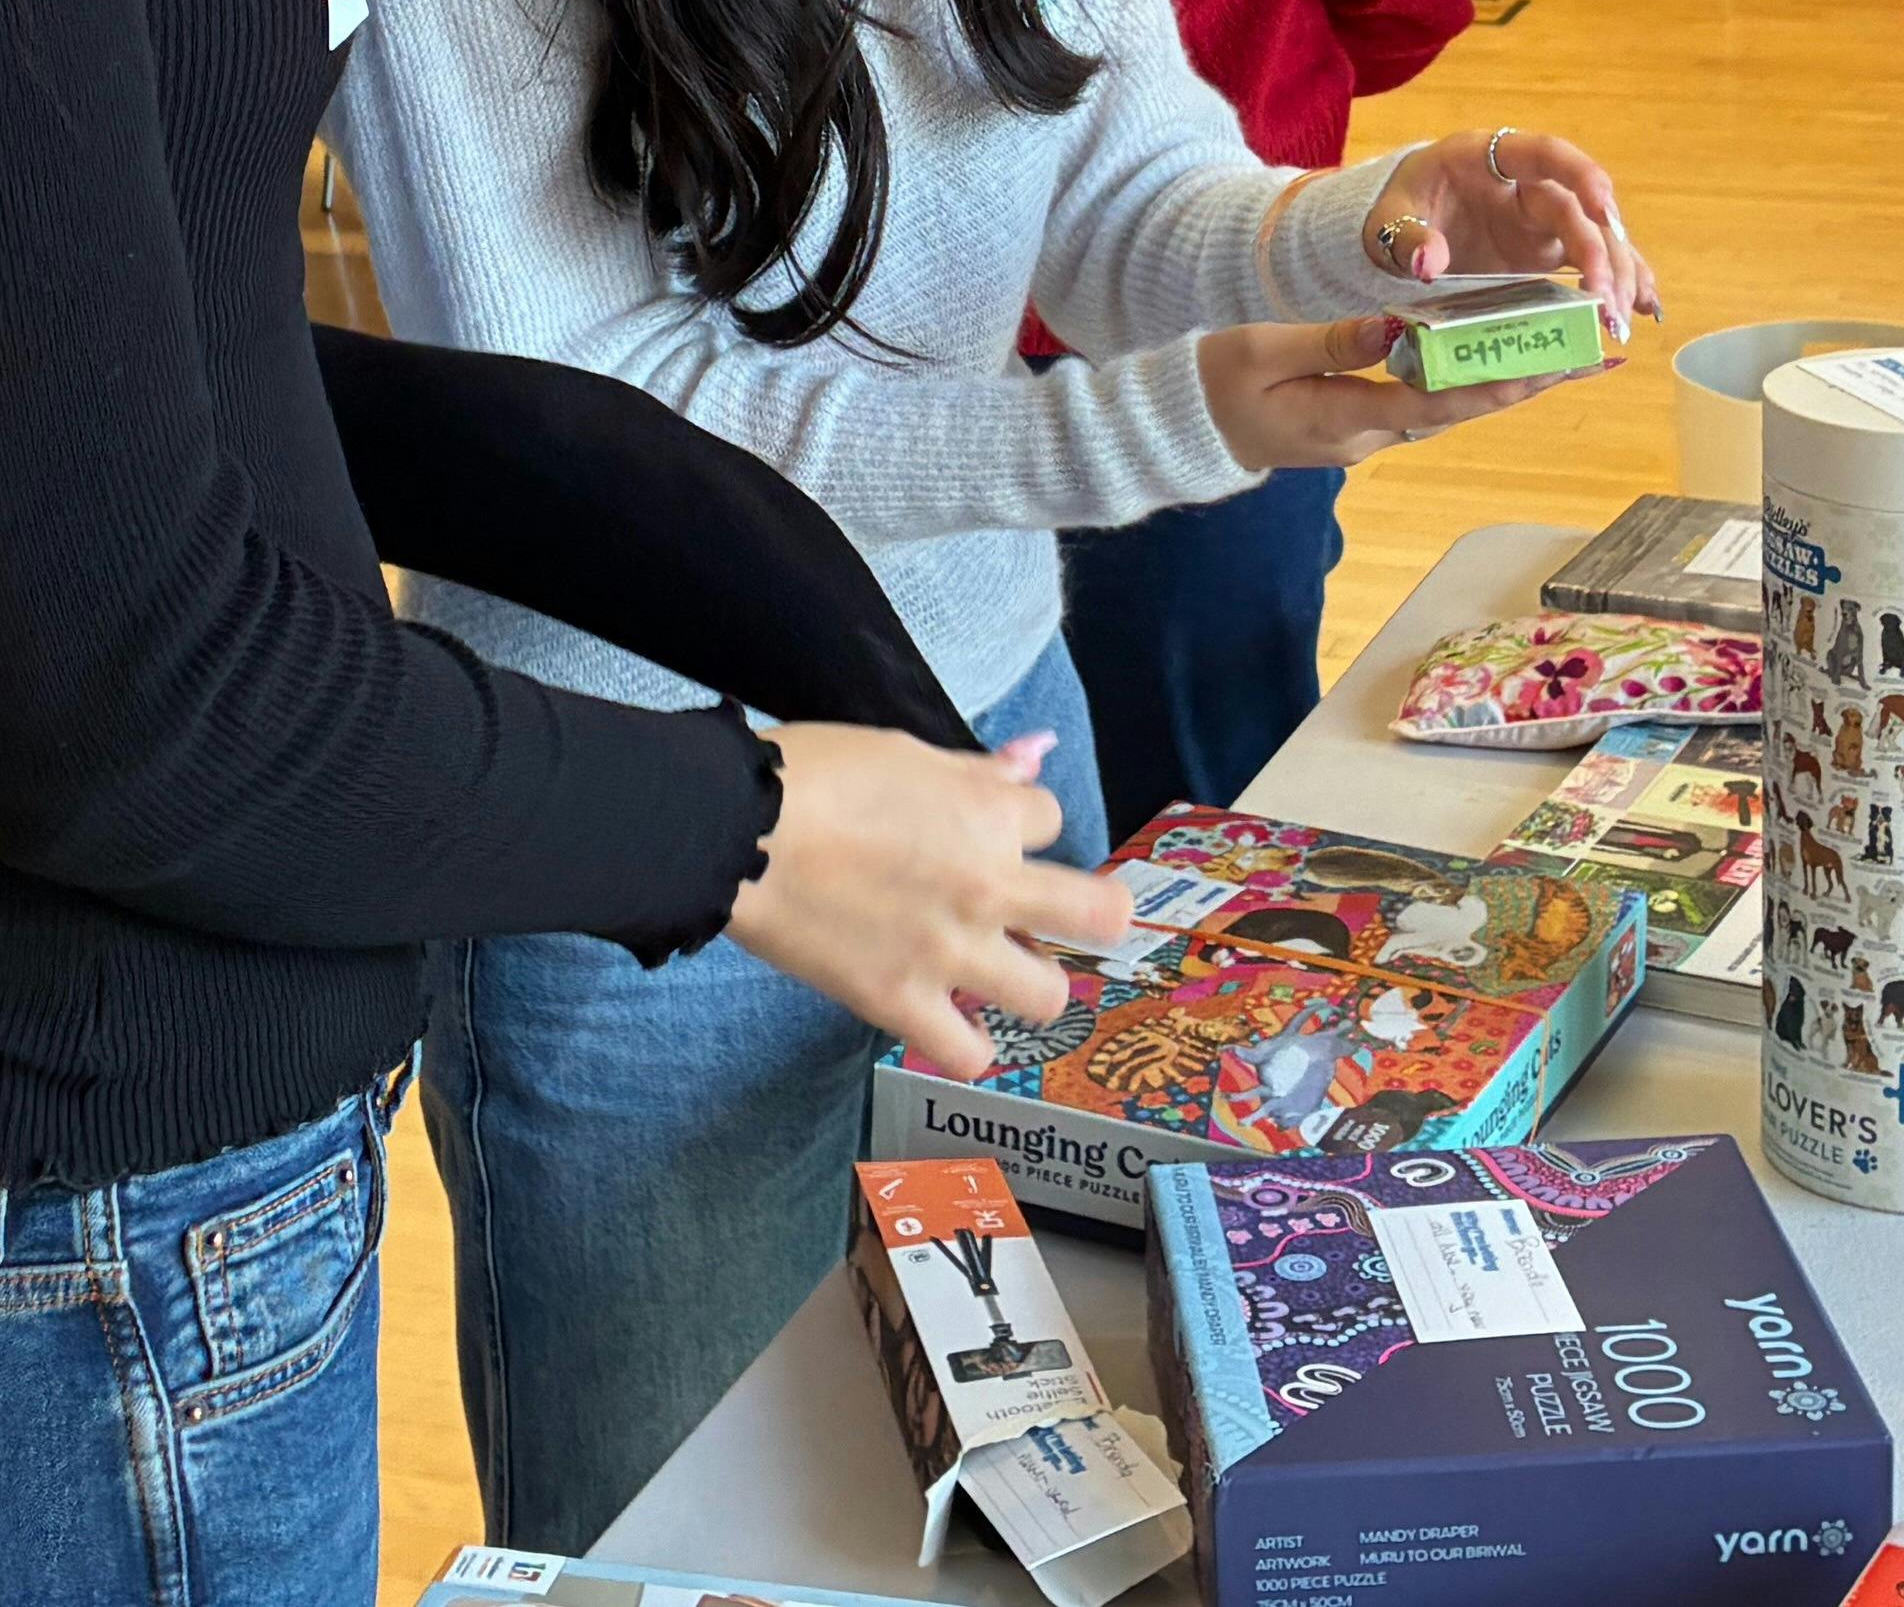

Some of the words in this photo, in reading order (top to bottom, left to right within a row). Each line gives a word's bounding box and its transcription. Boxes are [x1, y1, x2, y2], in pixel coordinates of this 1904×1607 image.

[1529, 1028, 1563, 1081] Cts
[1766, 1072, 1879, 1145] LOVER'S
[925, 1097, 1109, 1179] Lounging
[1780, 1118, 1855, 1166] PUZZLE
[1025, 1166, 1073, 1189] PIECE
[1078, 1177, 1140, 1205] PUZZLE
[1723, 1292, 1814, 1379] yarn
[1594, 1318, 1707, 1430] 1000
[1526, 1372, 1573, 1437] PUZZLE
[1560, 1369, 1616, 1435] JIGSAW
[1254, 1535, 1304, 1551] ARTIST
[1358, 1528, 1416, 1544] MANDY
[1418, 1524, 1480, 1541] DRAPER
[1254, 1554, 1332, 1571] ARTWORK
[1359, 1550, 1406, 1566] MURU
[1407, 1548, 1429, 1563] TO
[1429, 1546, 1464, 1562] OUR
[1464, 1542, 1528, 1559] BIRIWAL
[1713, 1527, 1809, 1564] yarn
[1255, 1575, 1289, 1592] 1000
[1289, 1574, 1332, 1590] PIECE
[1333, 1571, 1388, 1587] PUZZLE
